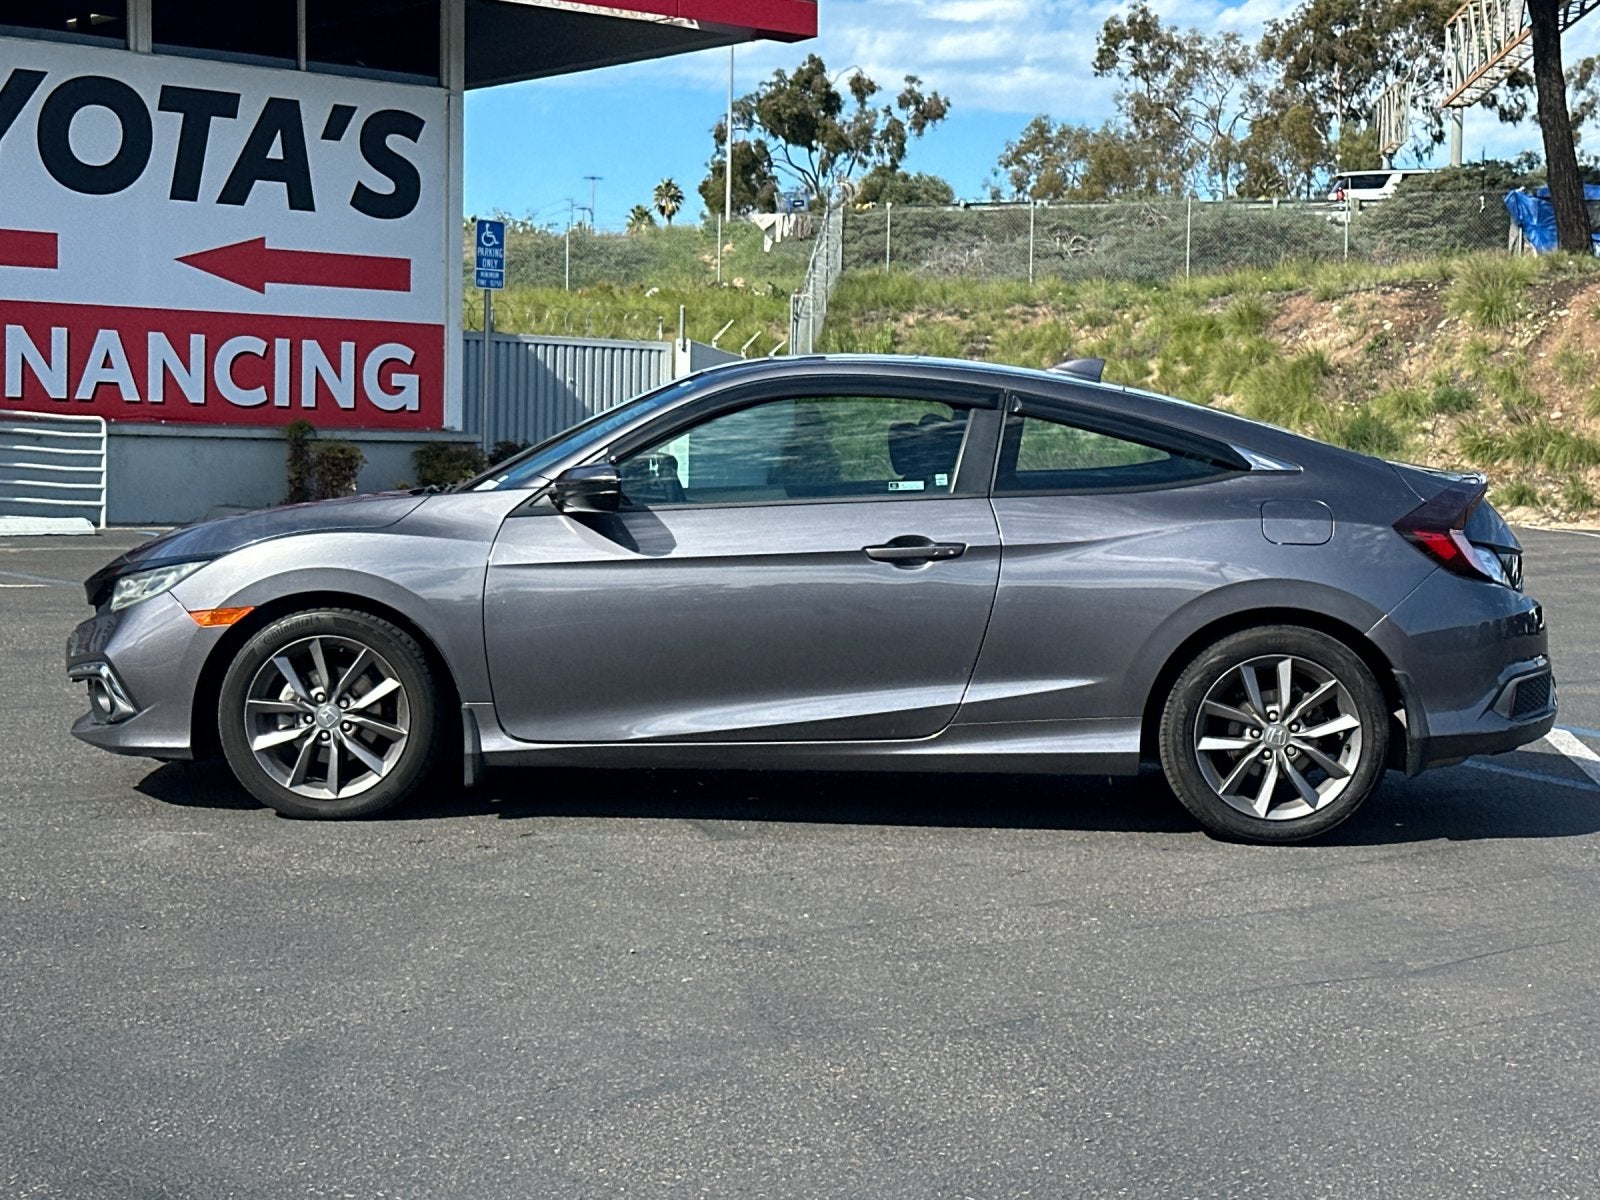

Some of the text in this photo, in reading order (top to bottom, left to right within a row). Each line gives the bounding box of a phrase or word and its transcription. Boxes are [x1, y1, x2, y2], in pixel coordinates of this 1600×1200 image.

[477, 246, 503, 259] PARKING
[482, 258, 499, 269] ONLY
[5, 324, 420, 412] NANCING
[263, 615, 313, 645] Continental
